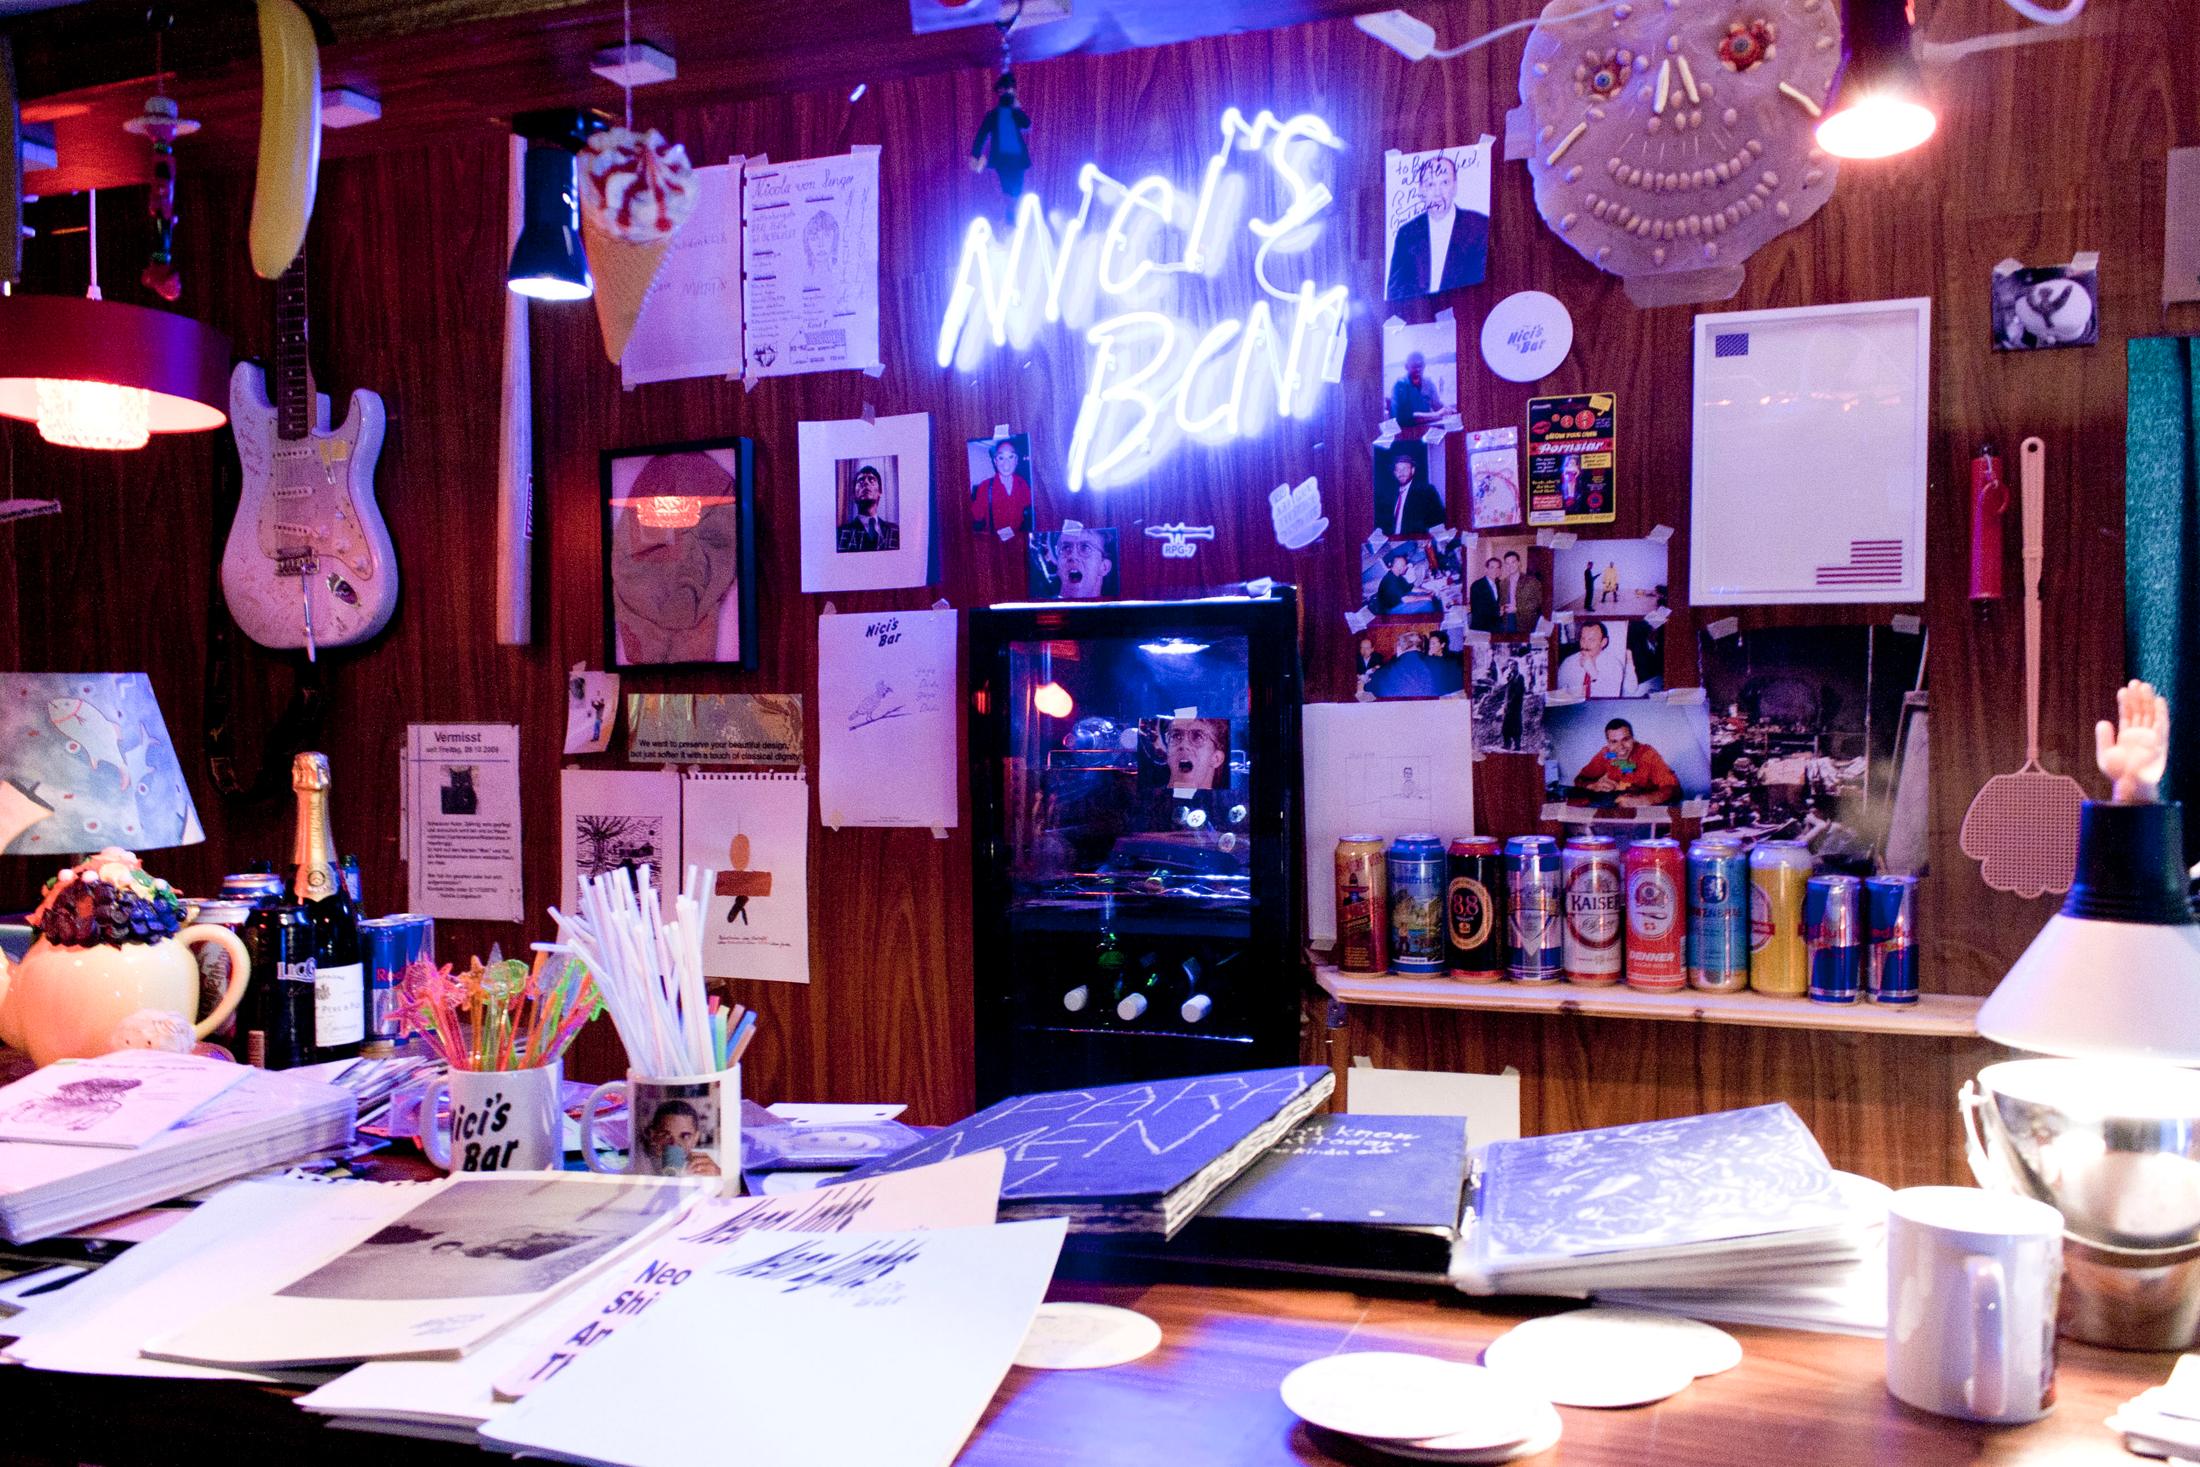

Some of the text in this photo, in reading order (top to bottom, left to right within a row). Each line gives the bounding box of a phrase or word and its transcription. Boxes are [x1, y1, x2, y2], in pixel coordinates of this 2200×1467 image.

[1507, 324, 1544, 345] Nici's
[1520, 340, 1546, 354] Bar
[1165, 543, 1194, 554] RPG-7
[865, 617, 899, 638] Nici's
[878, 632, 902, 647] Bar
[434, 732, 482, 742] Vermisst
[639, 739, 650, 747] We
[711, 742, 727, 750] your
[728, 741, 760, 749] beautiful
[709, 751, 730, 760] touch
[741, 751, 773, 760] classical
[1629, 951, 1674, 962] DENNER
[1335, 1125, 1421, 1140] know
[462, 1139, 519, 1171] Bar
[633, 1259, 693, 1286] Neo
